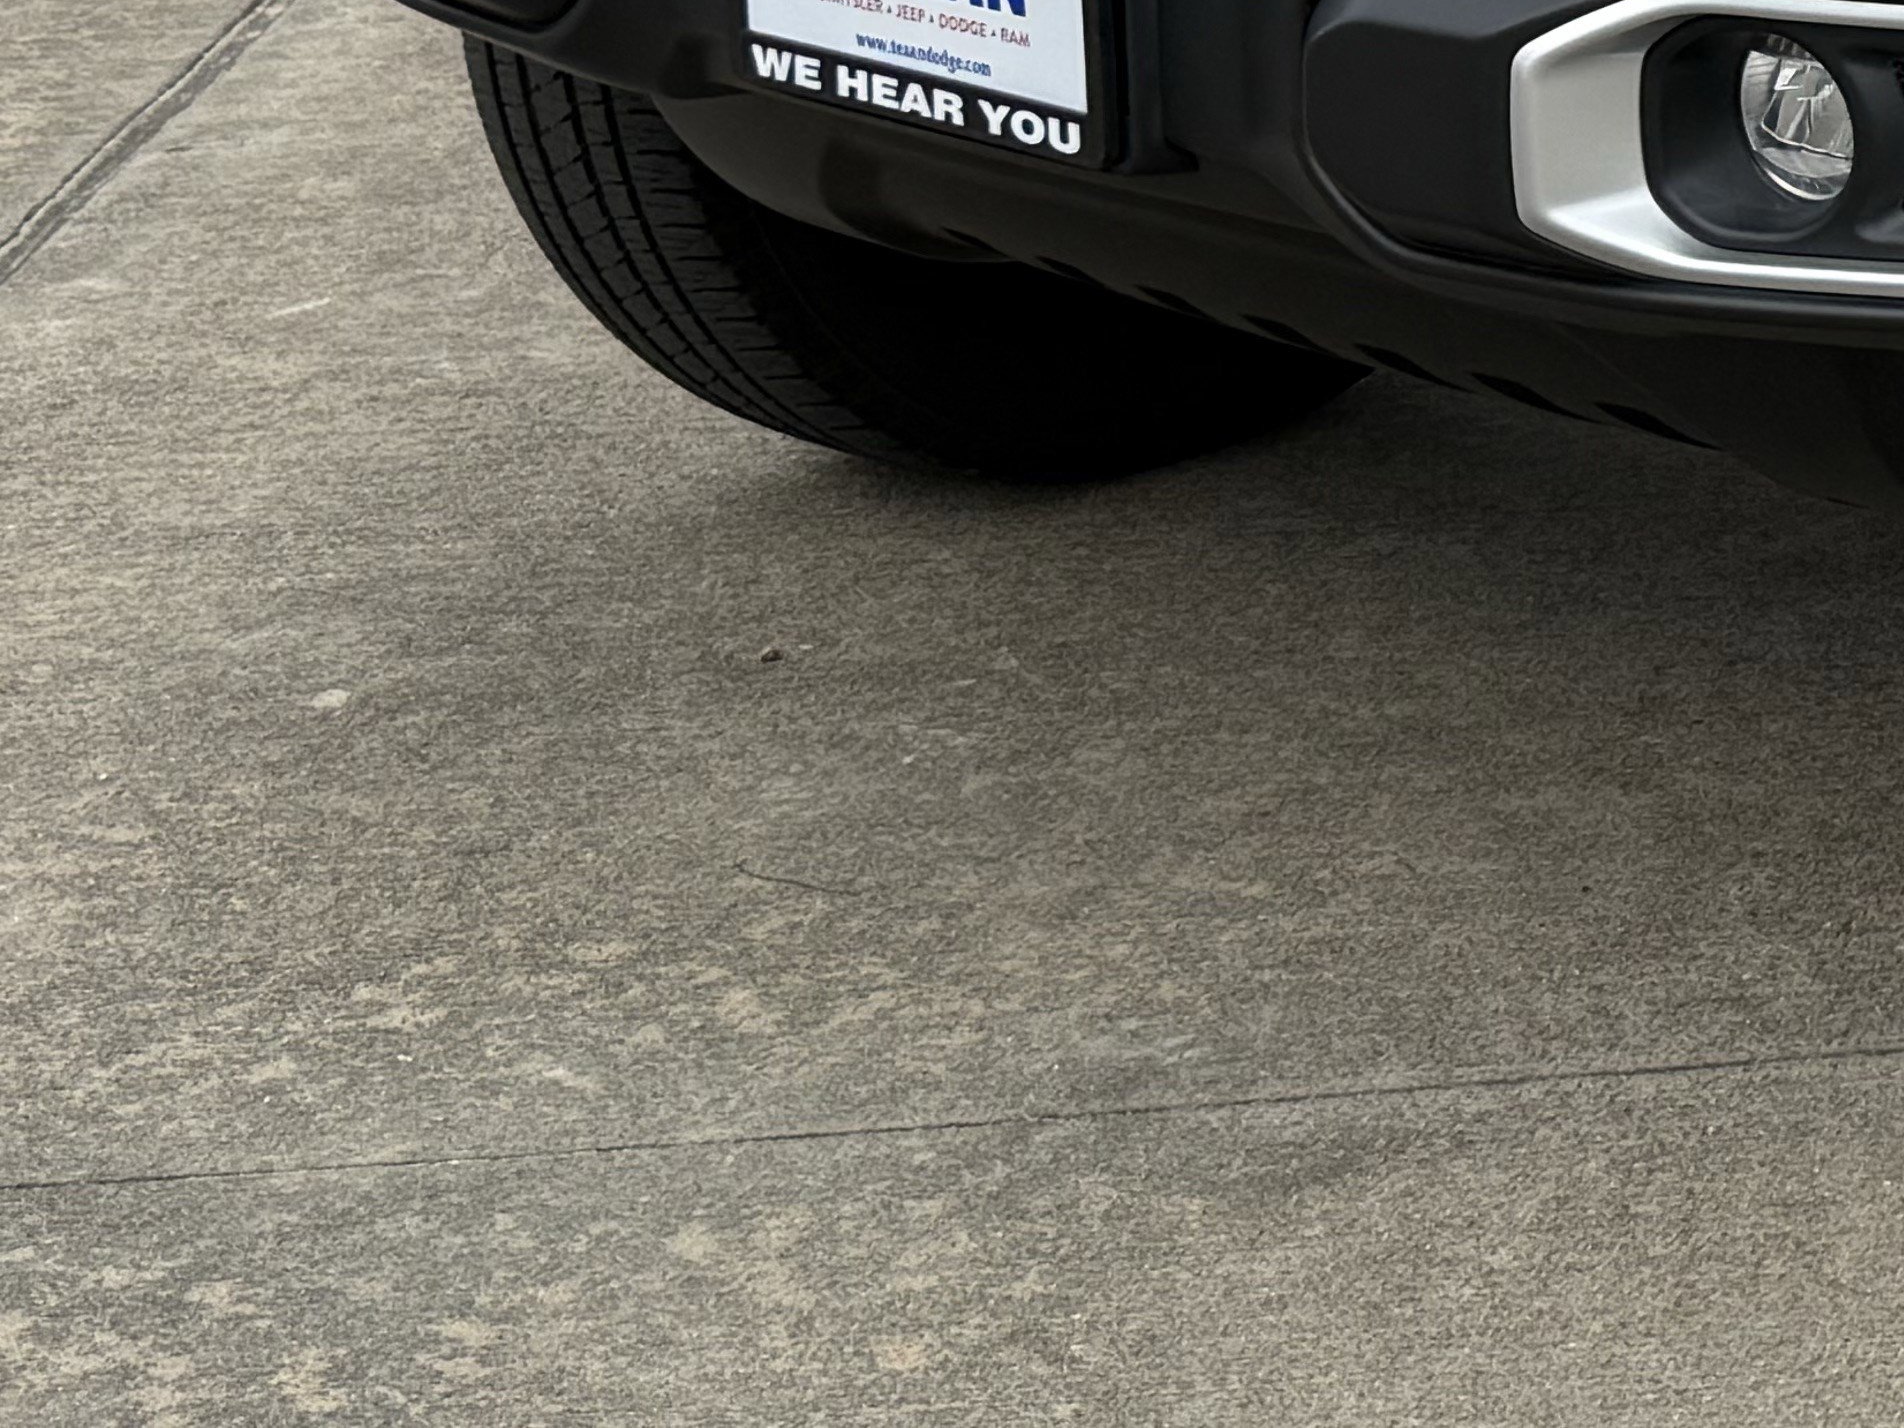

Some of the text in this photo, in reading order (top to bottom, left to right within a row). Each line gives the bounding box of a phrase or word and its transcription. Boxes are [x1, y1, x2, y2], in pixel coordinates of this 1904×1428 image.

[895, 4, 926, 23] JEEP
[937, 12, 987, 38] DODGE
[1000, 27, 1031, 48] RAM
[855, 33, 992, 76] www.texandodge.com
[751, 44, 1082, 155] WE HEAR YOU
